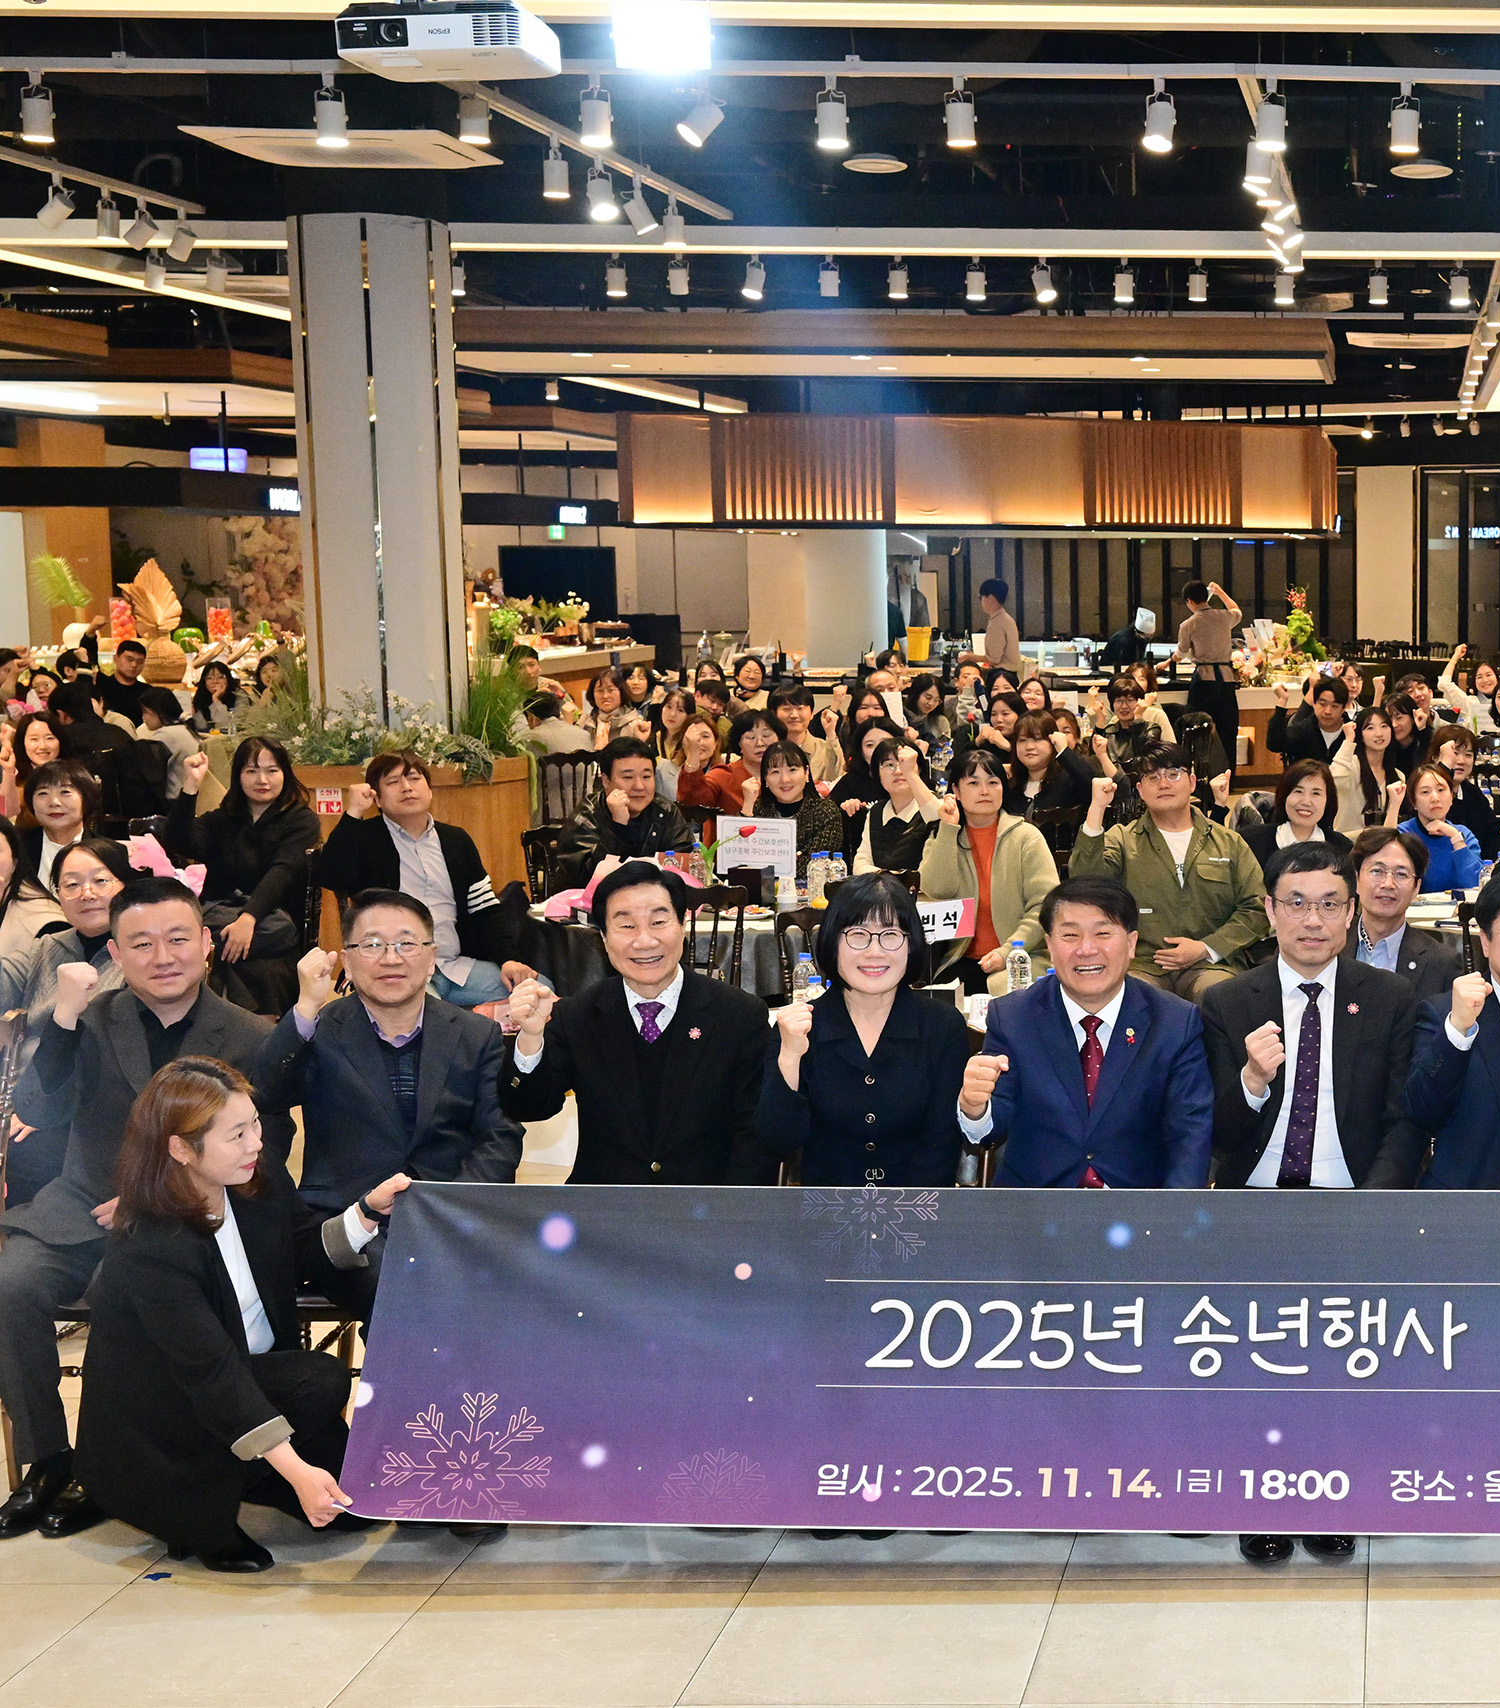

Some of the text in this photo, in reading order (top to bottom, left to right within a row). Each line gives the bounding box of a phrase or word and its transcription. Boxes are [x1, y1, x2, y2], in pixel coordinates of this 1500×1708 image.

[752, 848, 790, 857] 주간보호센터
[865, 1296, 1467, 1378] 2025년 송년행사
[911, 1466, 1022, 1498] 2025.
[1039, 1467, 1092, 1498] 11.
[1106, 1469, 1162, 1499] 14.
[1240, 1469, 1350, 1501] 18:00
